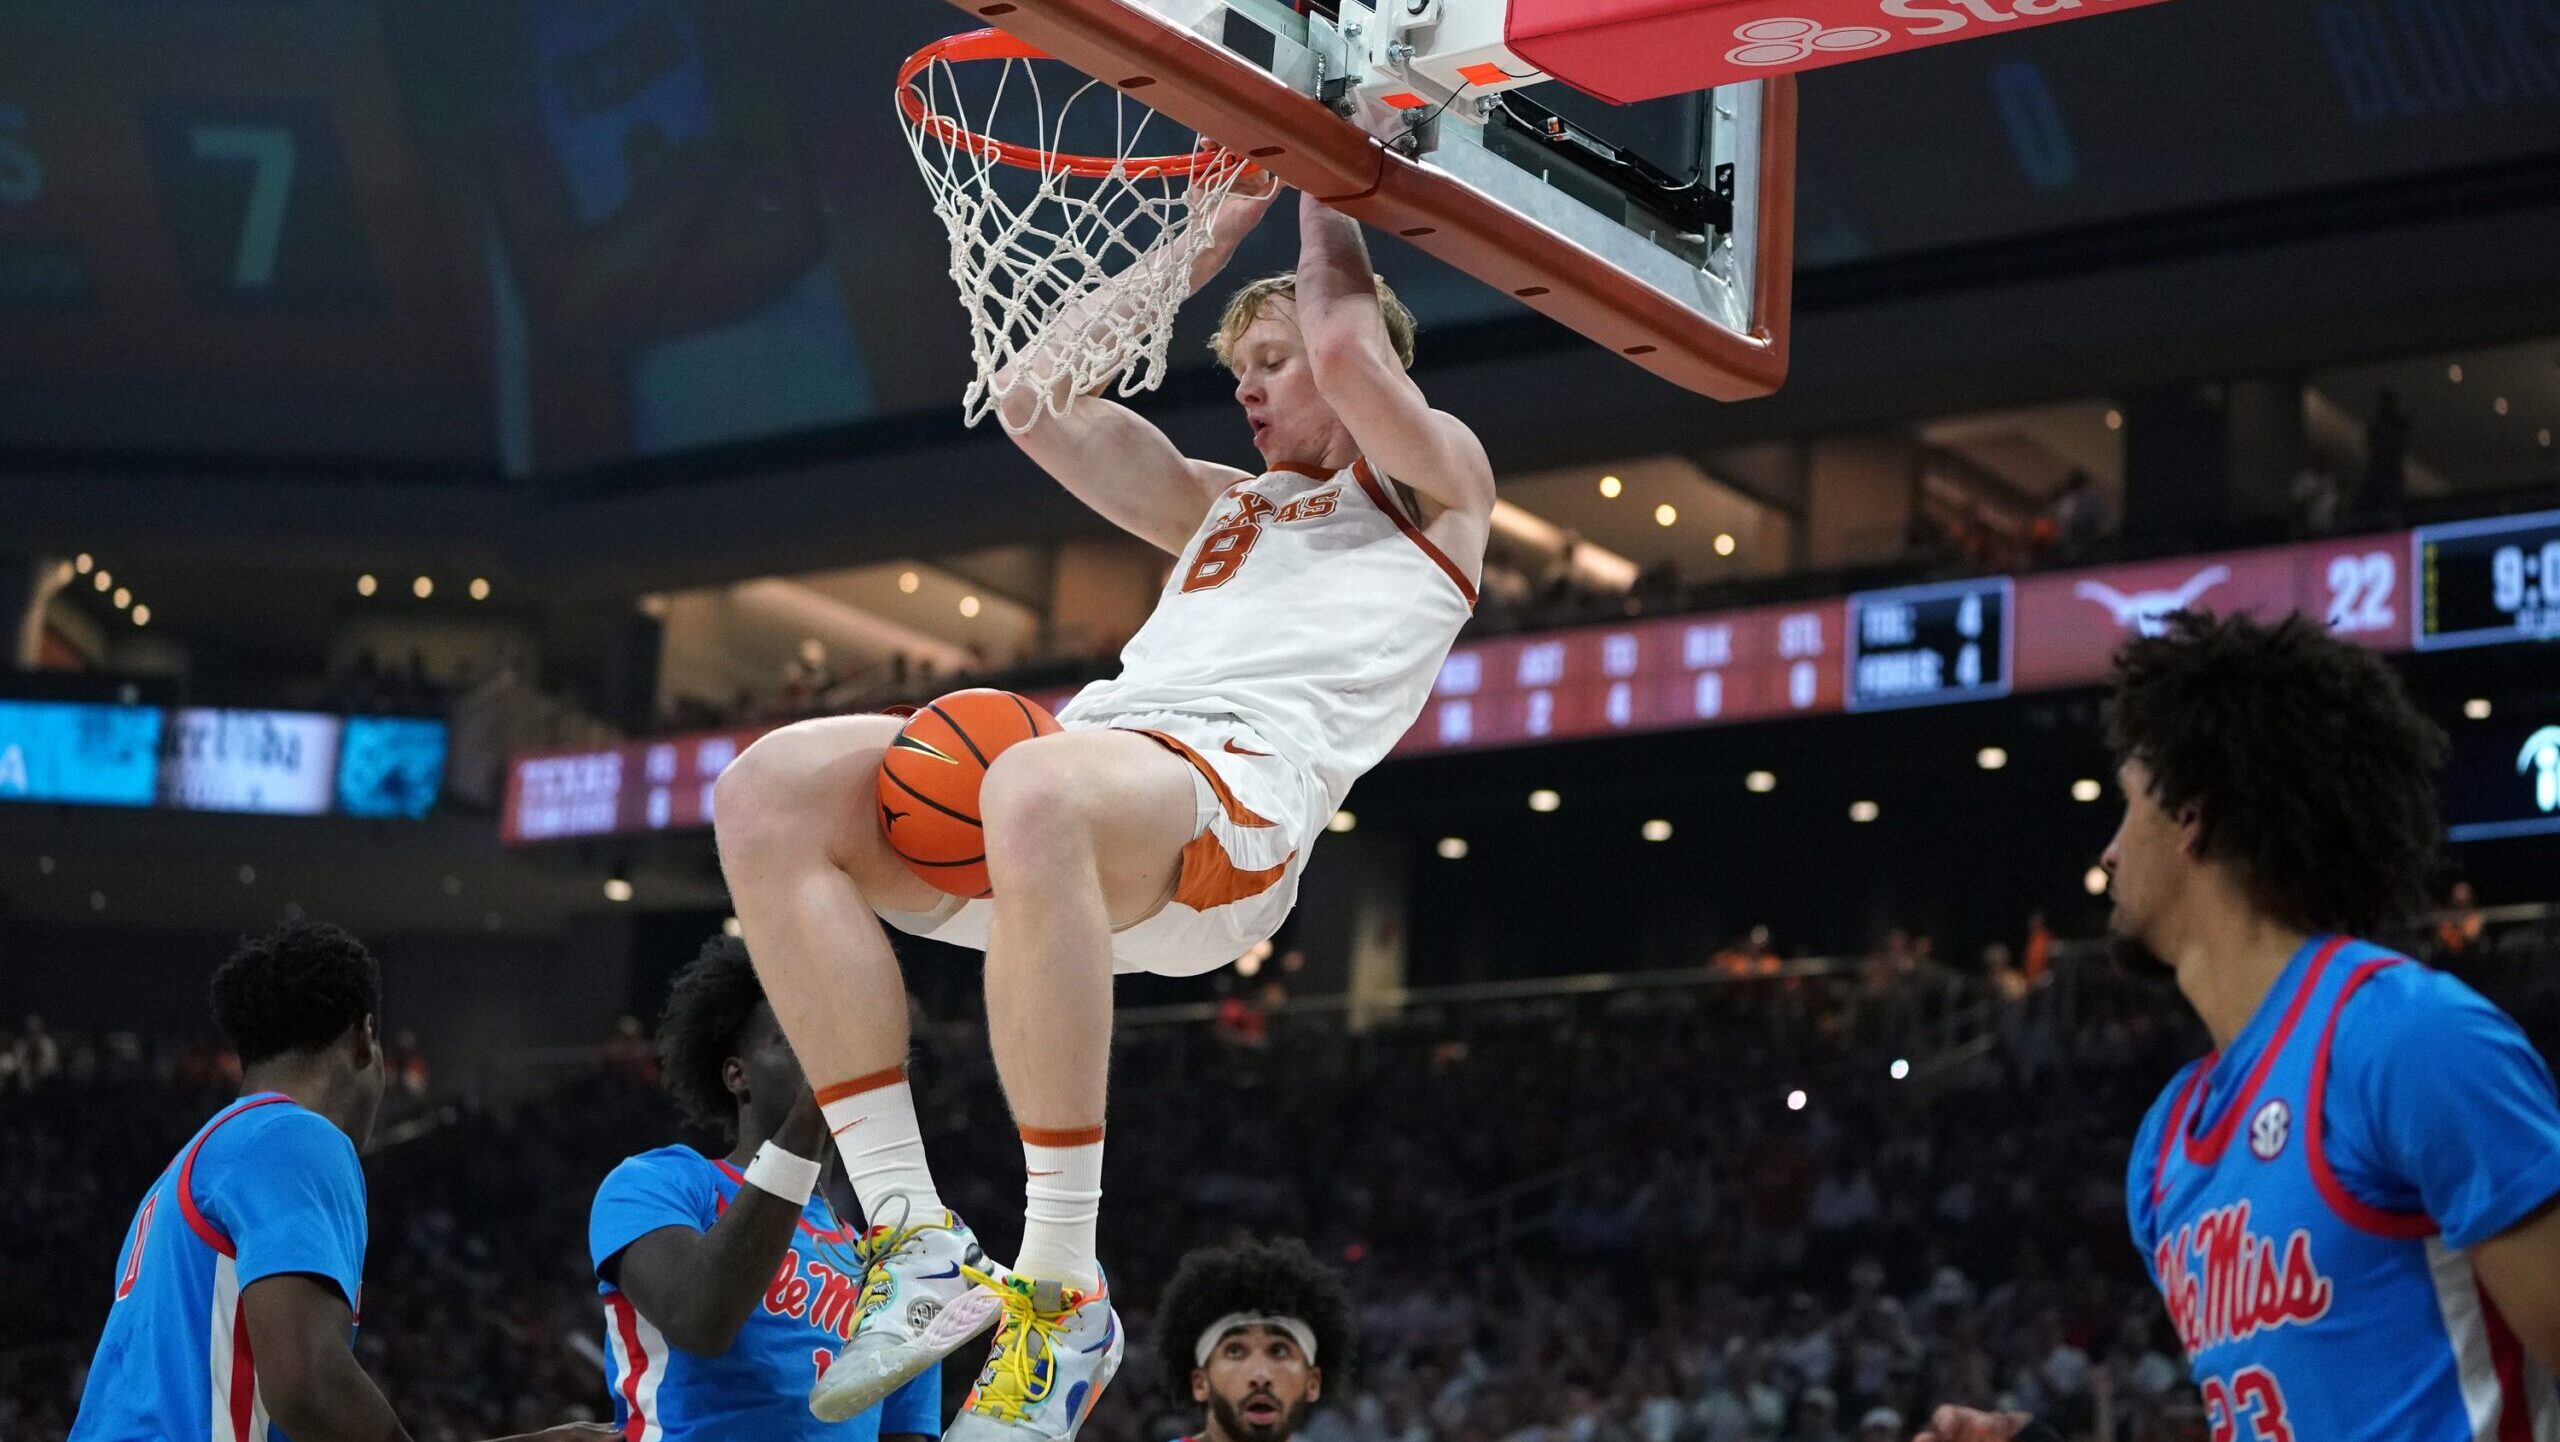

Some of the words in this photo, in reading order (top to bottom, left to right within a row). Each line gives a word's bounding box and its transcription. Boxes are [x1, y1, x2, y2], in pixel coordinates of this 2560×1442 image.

[187, 122, 297, 289] 7
[1211, 486, 1342, 529] XAS
[2326, 551, 2397, 634] 22
[2193, 1199, 2333, 1351] Miss
